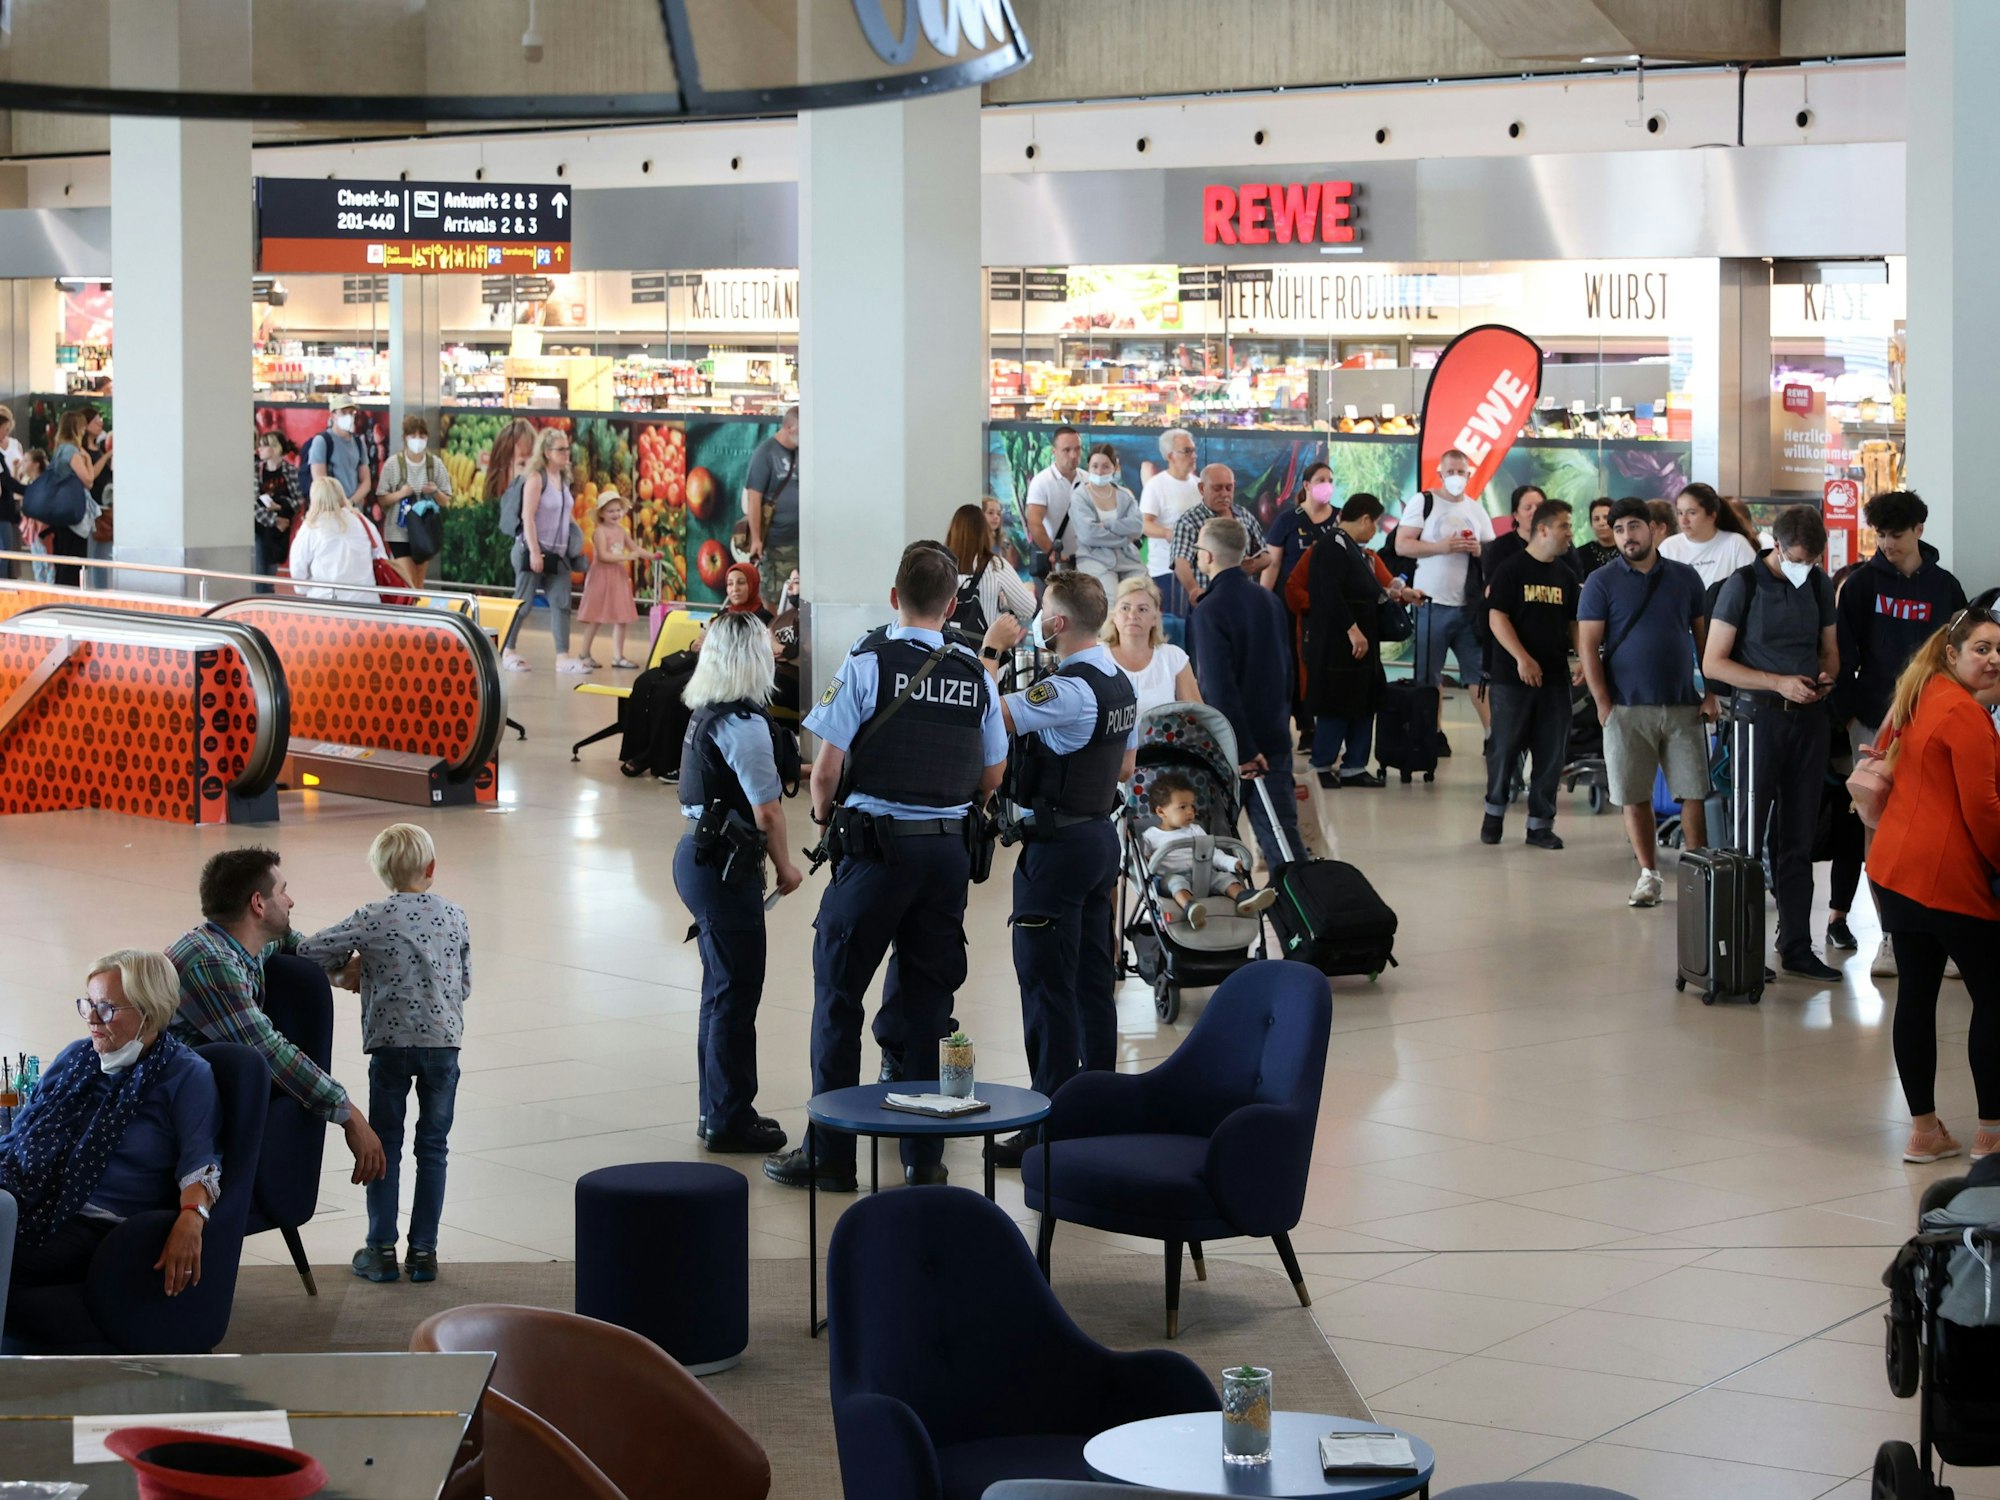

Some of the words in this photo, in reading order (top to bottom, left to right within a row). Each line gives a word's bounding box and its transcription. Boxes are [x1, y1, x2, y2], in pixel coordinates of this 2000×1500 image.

[337, 188, 400, 207] Check-in
[443, 191, 499, 209] Ankunft
[500, 192, 511, 210] 2
[514, 192, 526, 210] &
[528, 192, 538, 210] 3
[337, 212, 396, 230] 201-440
[1202, 181, 1354, 245] REWE
[443, 215, 497, 233] Arrivals
[500, 216, 511, 234] 2
[514, 216, 526, 234] &
[528, 216, 538, 234] 3
[488, 248, 502, 264] P2
[692, 275, 799, 319] KALTGETRÄN
[1585, 272, 1669, 320] WURST
[1786, 388, 1809, 398] REWE
[1437, 369, 1530, 478] EWE
[1784, 428, 1833, 444] Herzlich
[1784, 444, 1857, 460] willkommen
[1524, 584, 1563, 605] MARVEL
[894, 672, 979, 708] POLIZEI
